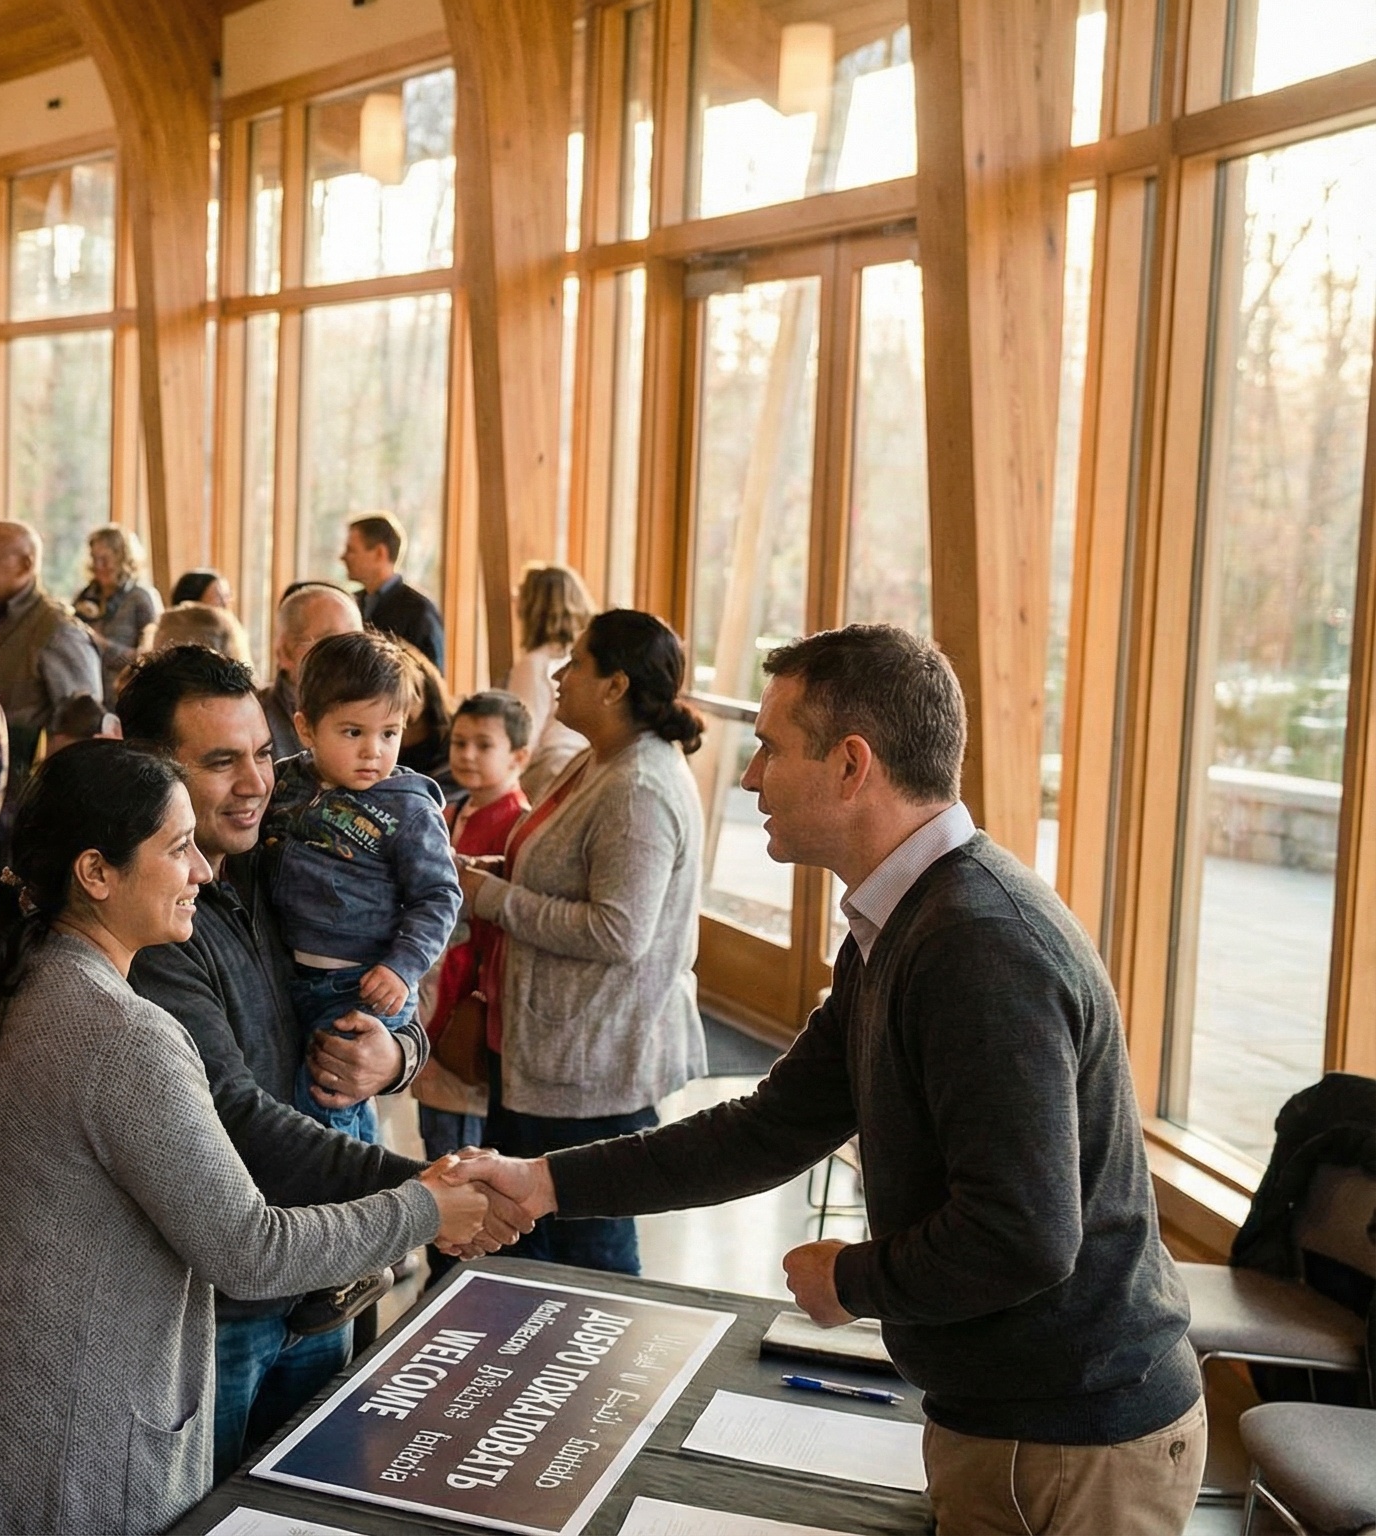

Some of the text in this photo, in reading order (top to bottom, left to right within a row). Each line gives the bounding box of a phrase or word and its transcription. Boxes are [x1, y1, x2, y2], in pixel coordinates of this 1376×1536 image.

[357, 1328, 488, 1421] WELCOME
[555, 1307, 634, 1366] ДОБРО
[446, 1363, 591, 1490] ПОЖАЛОВАТЬ
